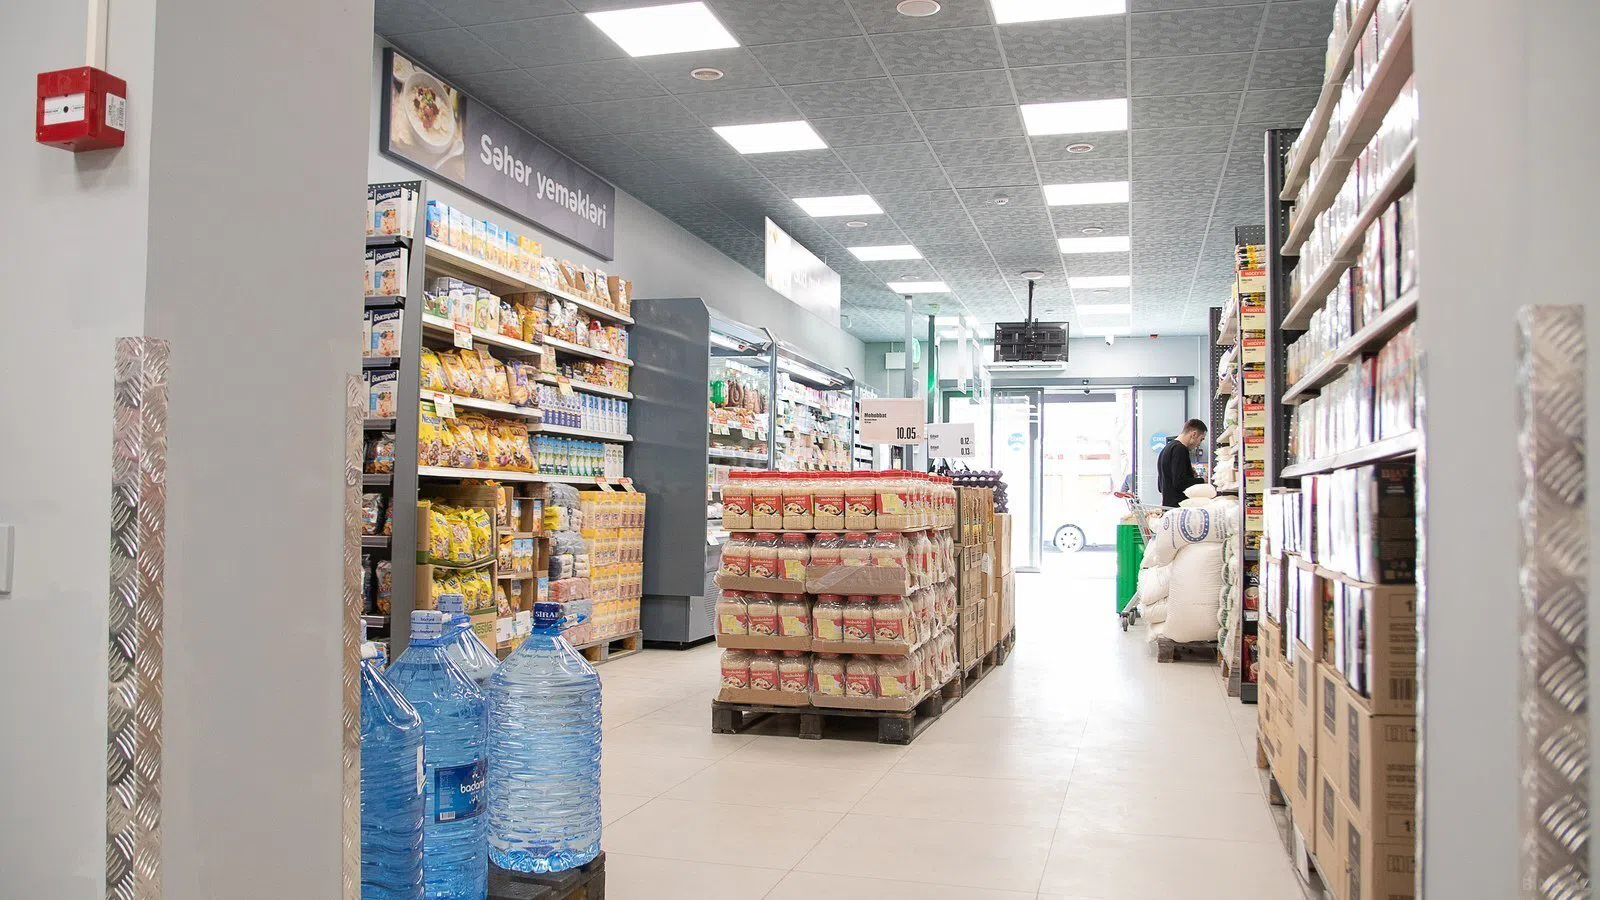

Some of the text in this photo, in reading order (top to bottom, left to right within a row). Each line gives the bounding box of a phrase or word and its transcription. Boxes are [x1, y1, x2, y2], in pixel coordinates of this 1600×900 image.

[480, 133, 607, 229] Səhər yeməkləri
[896, 426, 917, 440] 10.05
[960, 437, 970, 445] 0.12
[961, 447, 971, 456] 0.13
